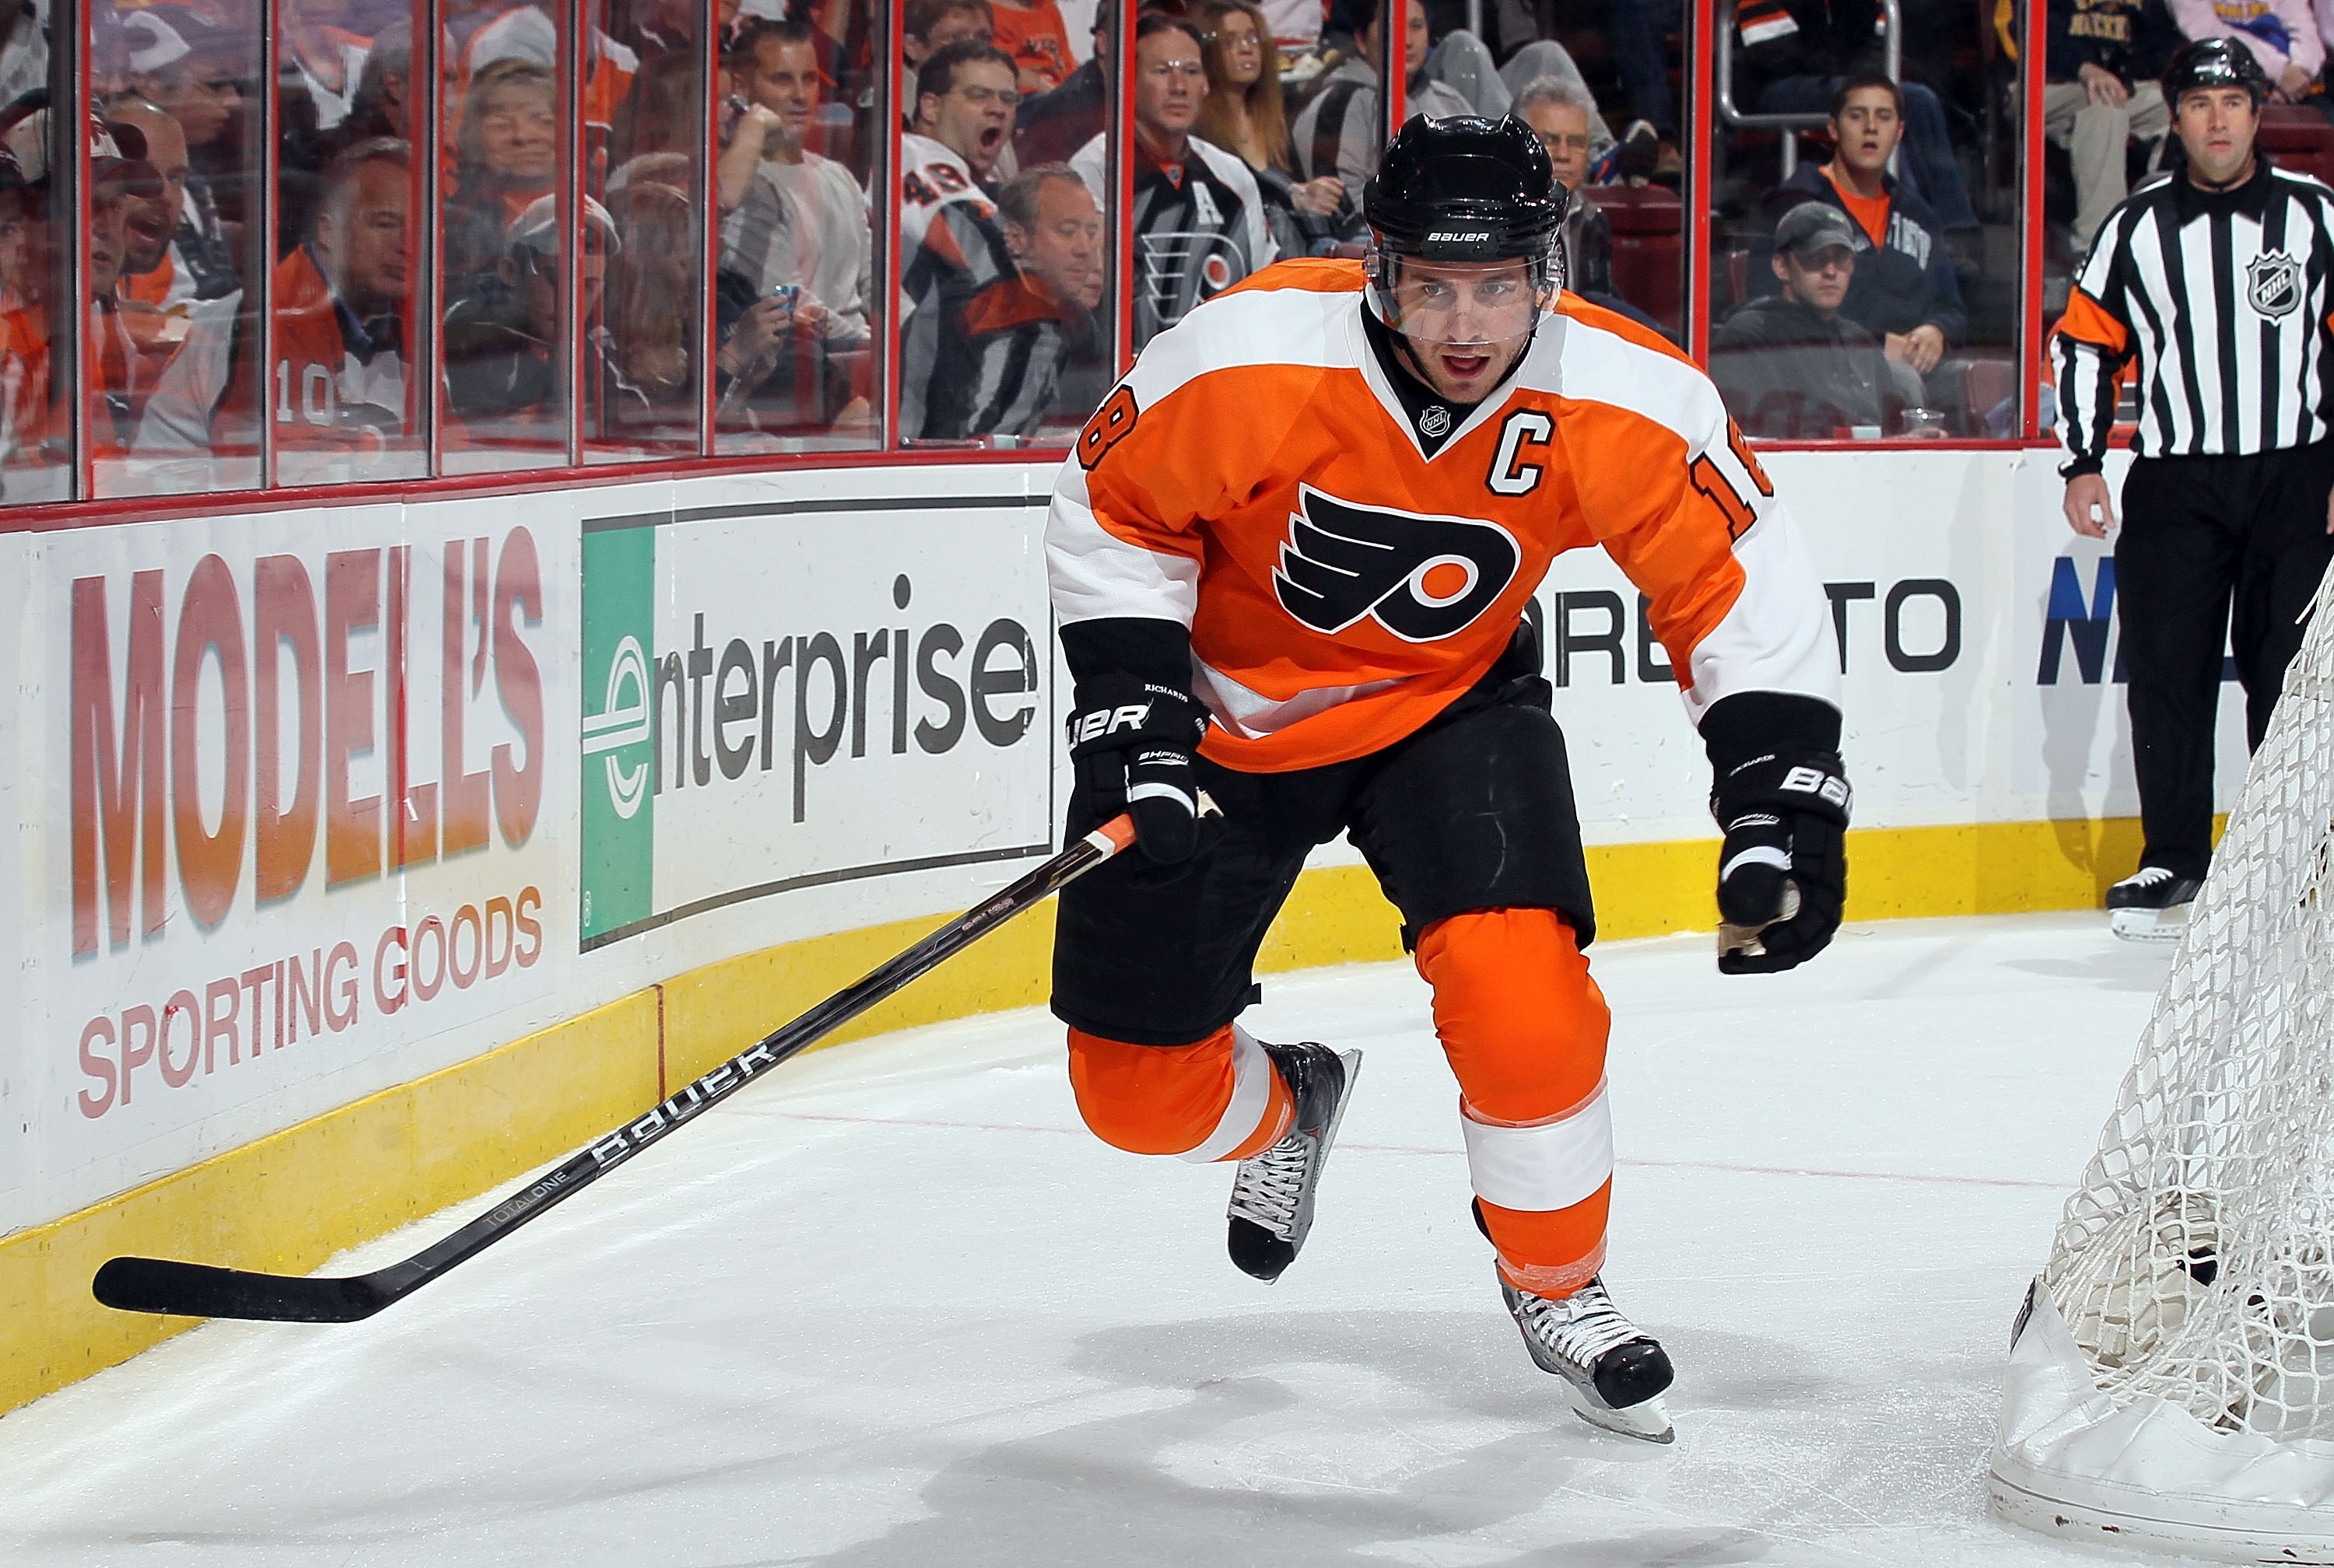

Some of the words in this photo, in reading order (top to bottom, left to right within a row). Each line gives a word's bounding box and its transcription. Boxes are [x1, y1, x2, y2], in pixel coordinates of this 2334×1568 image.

[1191, 180, 1225, 225] A
[276, 359, 335, 427] 10
[1485, 407, 1556, 498] C
[72, 526, 545, 961] MODELL'S
[582, 574, 1037, 824] enterprise
[77, 940, 359, 1119] SPORTING
[373, 885, 543, 1015] GOODS
